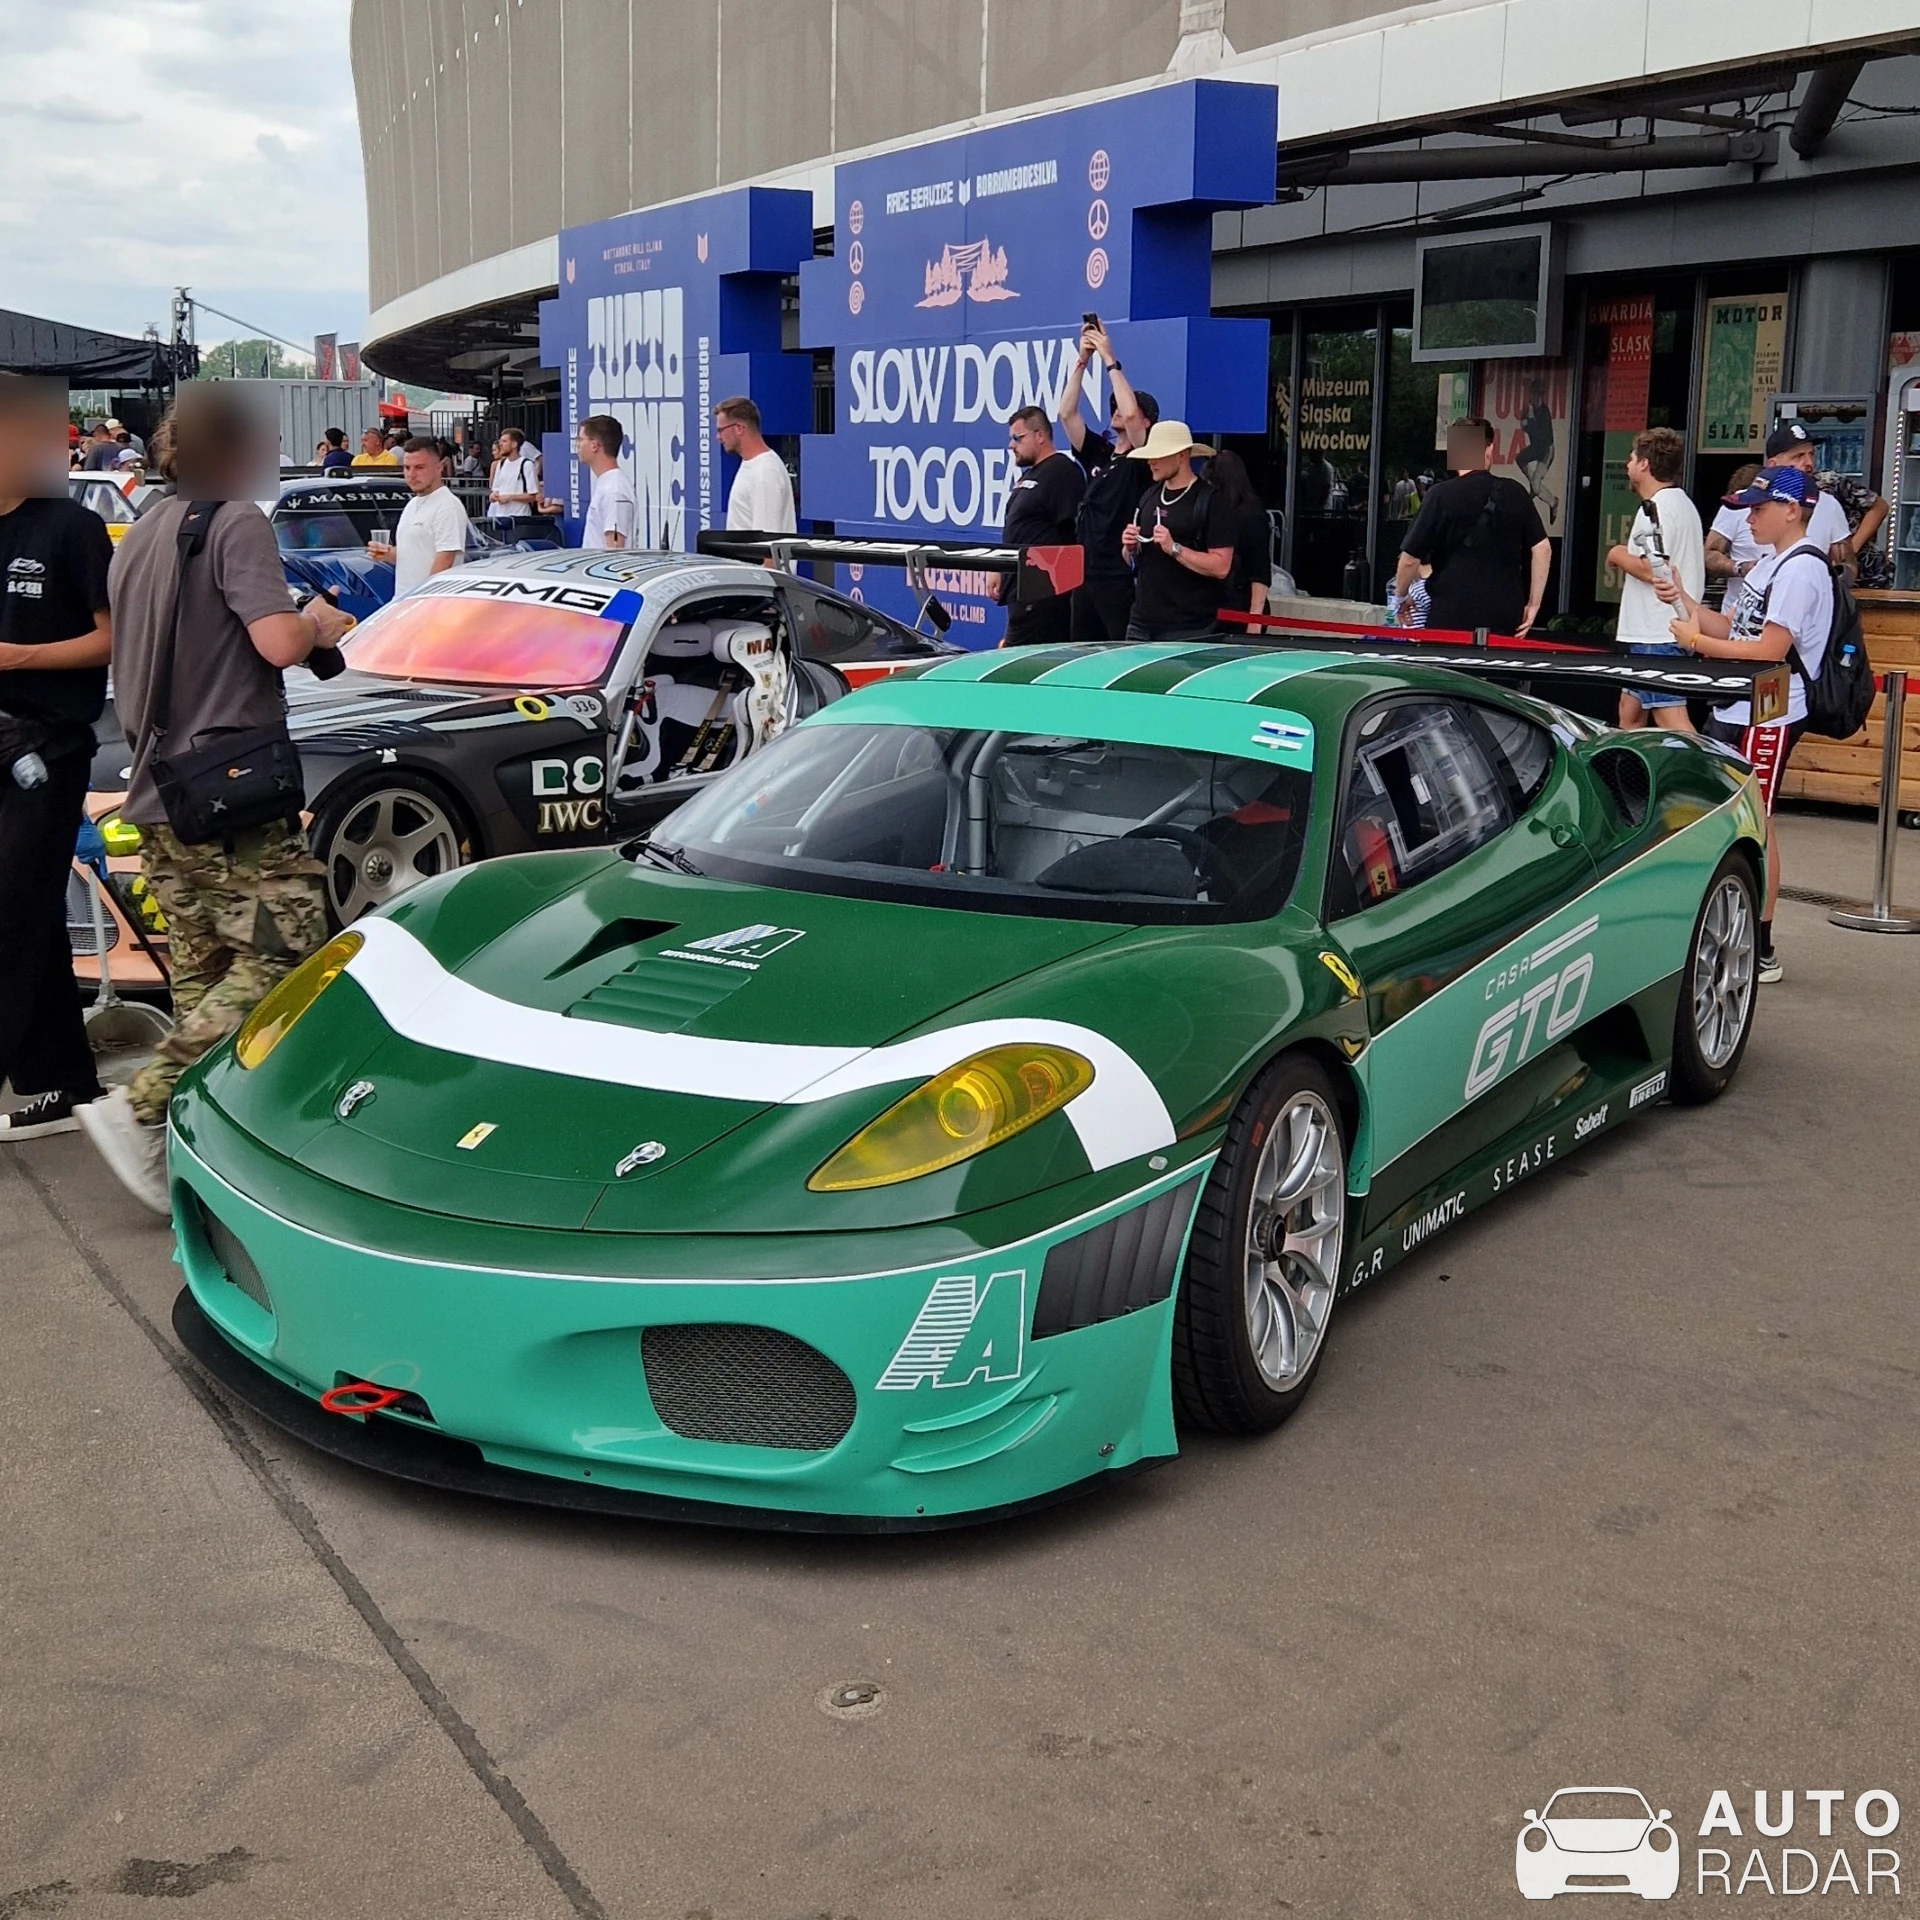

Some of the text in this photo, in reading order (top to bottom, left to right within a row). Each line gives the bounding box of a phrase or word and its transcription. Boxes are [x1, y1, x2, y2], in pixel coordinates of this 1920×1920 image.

[887, 160, 1058, 215] RACE SERVICE BORROMEODESILVA
[1589, 302, 1653, 323] GWARDIA
[1716, 305, 1783, 325] MOTOR
[588, 287, 684, 400] TUTTO
[1611, 334, 1651, 355] ŚLĄSK
[850, 336, 1103, 425] SLOW DOWN
[1301, 378, 1370, 397] Muzeum
[1301, 399, 1351, 426] Śląska
[698, 337, 711, 530] BORROMEODESILVA
[1301, 430, 1370, 450] Wrocław
[1708, 421, 1766, 442] ŚLĄS
[308, 491, 417, 505] MASERAT
[569, 460, 580, 518] RACE
[454, 580, 613, 612] AMG
[959, 604, 986, 625] CLIMB
[1556, 665, 1752, 688] AMOS
[572, 700, 597, 713] 336
[537, 799, 602, 834] IWC
[658, 950, 760, 970] AUTOMOBILI AMOS
[1484, 956, 1531, 1001] CASA
[1464, 952, 1594, 1101] GTO
[1629, 1071, 1667, 1110] PIRELLI
[1574, 1104, 1610, 1140] Sabelt
[1402, 1191, 1466, 1252] UNIMATIC
[1493, 1136, 1557, 1191] SEASE
